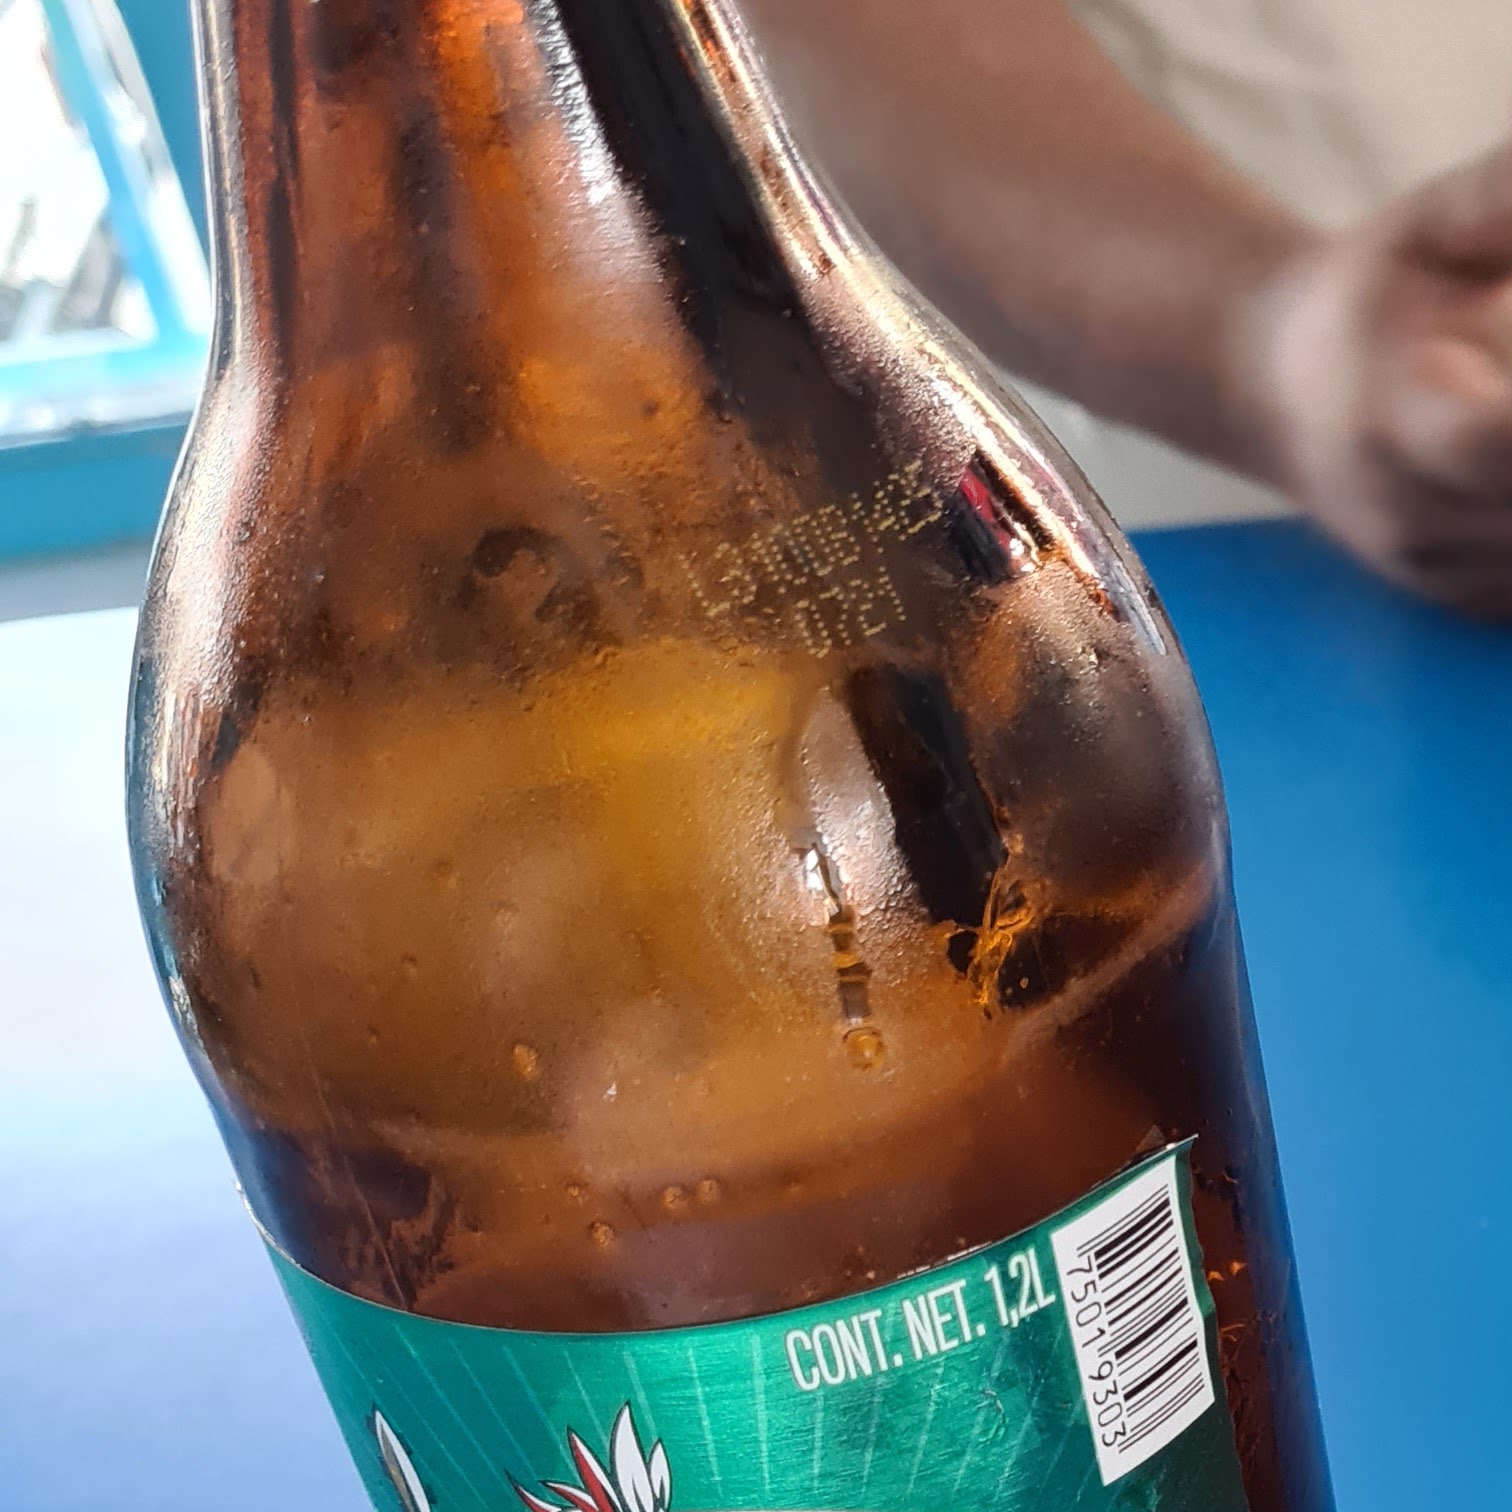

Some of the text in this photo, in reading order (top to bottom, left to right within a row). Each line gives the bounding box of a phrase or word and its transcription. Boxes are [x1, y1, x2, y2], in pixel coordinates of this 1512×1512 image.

[785, 1246, 1056, 1391] CONT. NET. 1,2L
